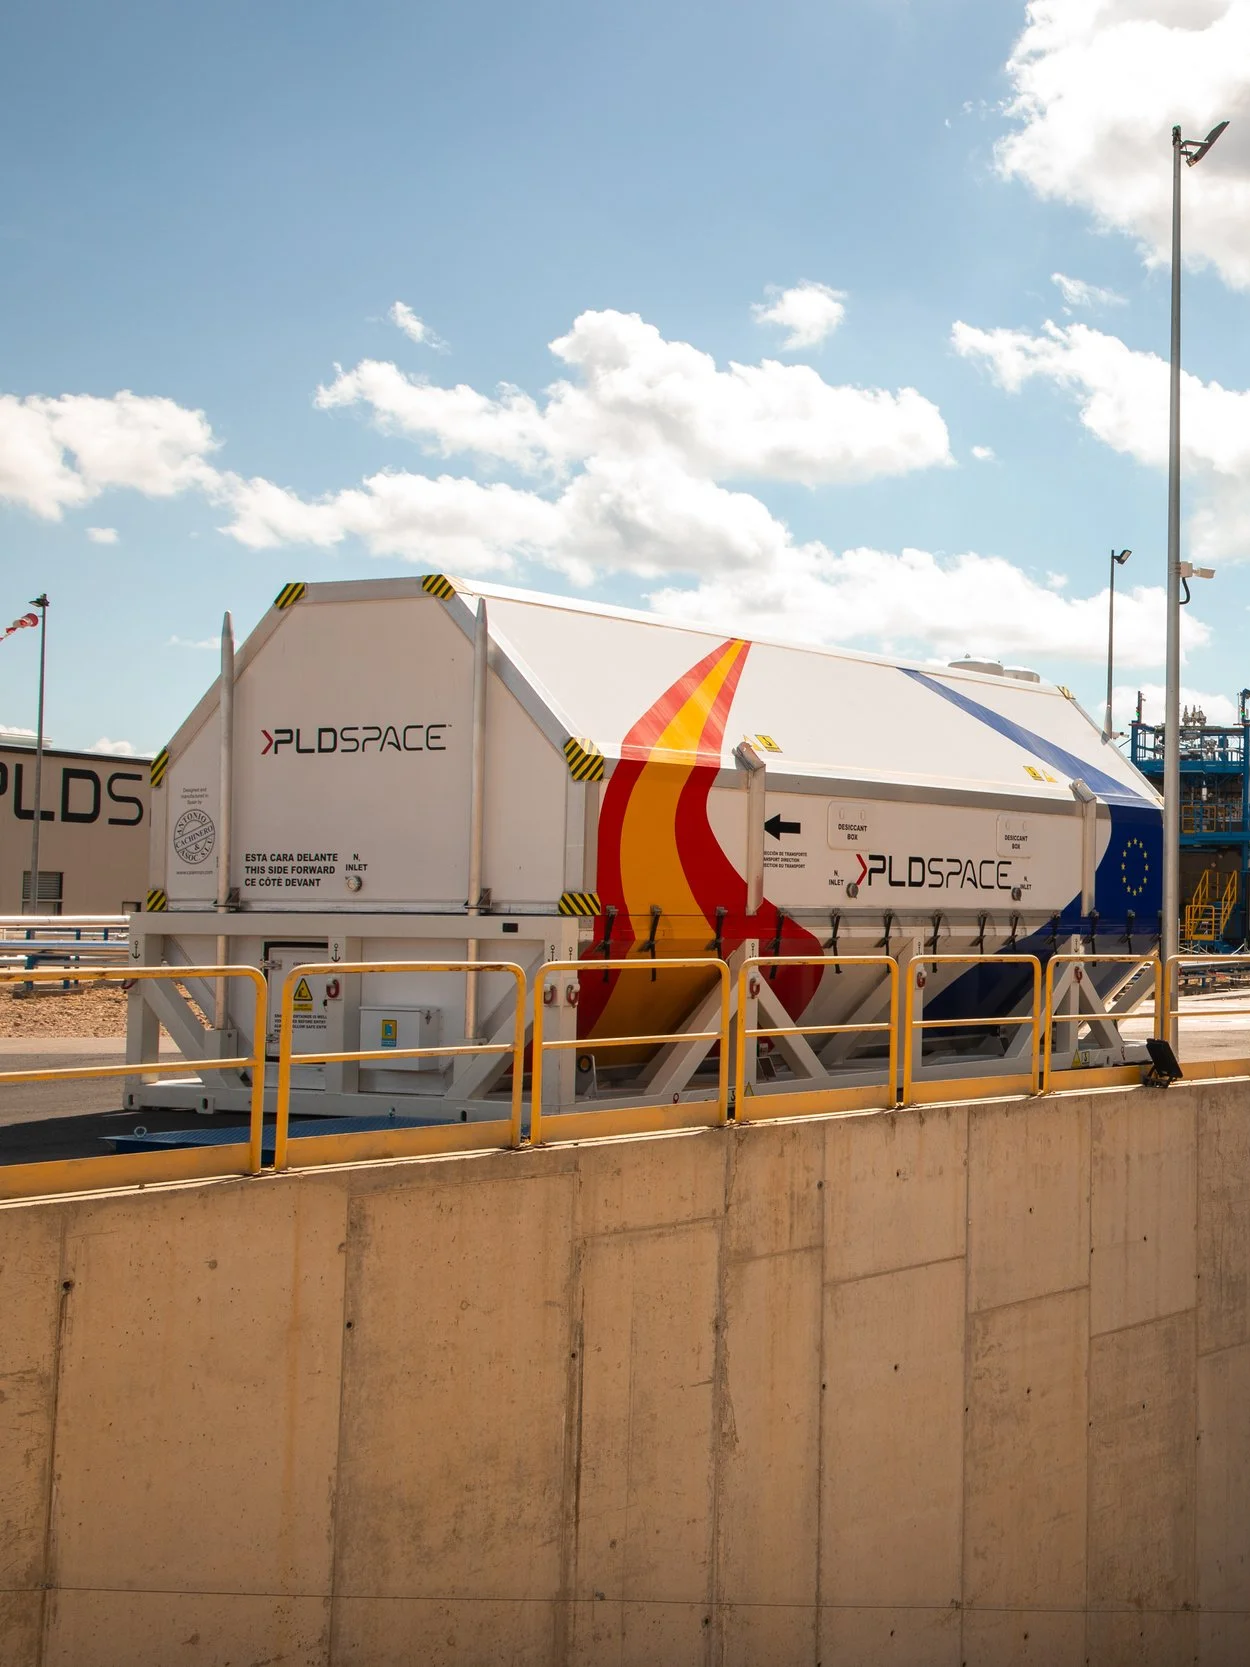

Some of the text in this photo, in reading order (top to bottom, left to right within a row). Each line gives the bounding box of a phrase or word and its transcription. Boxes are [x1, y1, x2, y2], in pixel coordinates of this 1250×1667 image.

[274, 724, 447, 755] PLDSPACE
[0, 761, 144, 827] LDS
[177, 812, 207, 836] ANTONIO
[838, 823, 868, 832] DESICCANT
[175, 825, 214, 849] CACHINERO
[847, 833, 858, 841] BOX
[1004, 834, 1028, 842] DESICCANT
[245, 853, 339, 862] ESTA CARA DELANTE
[245, 865, 336, 874] THIS SIDE FORWARD
[345, 863, 368, 871] INLET
[868, 854, 1012, 890] PLDSPACE
[244, 878, 256, 887] CE
[285, 878, 321, 887] DEVANT
